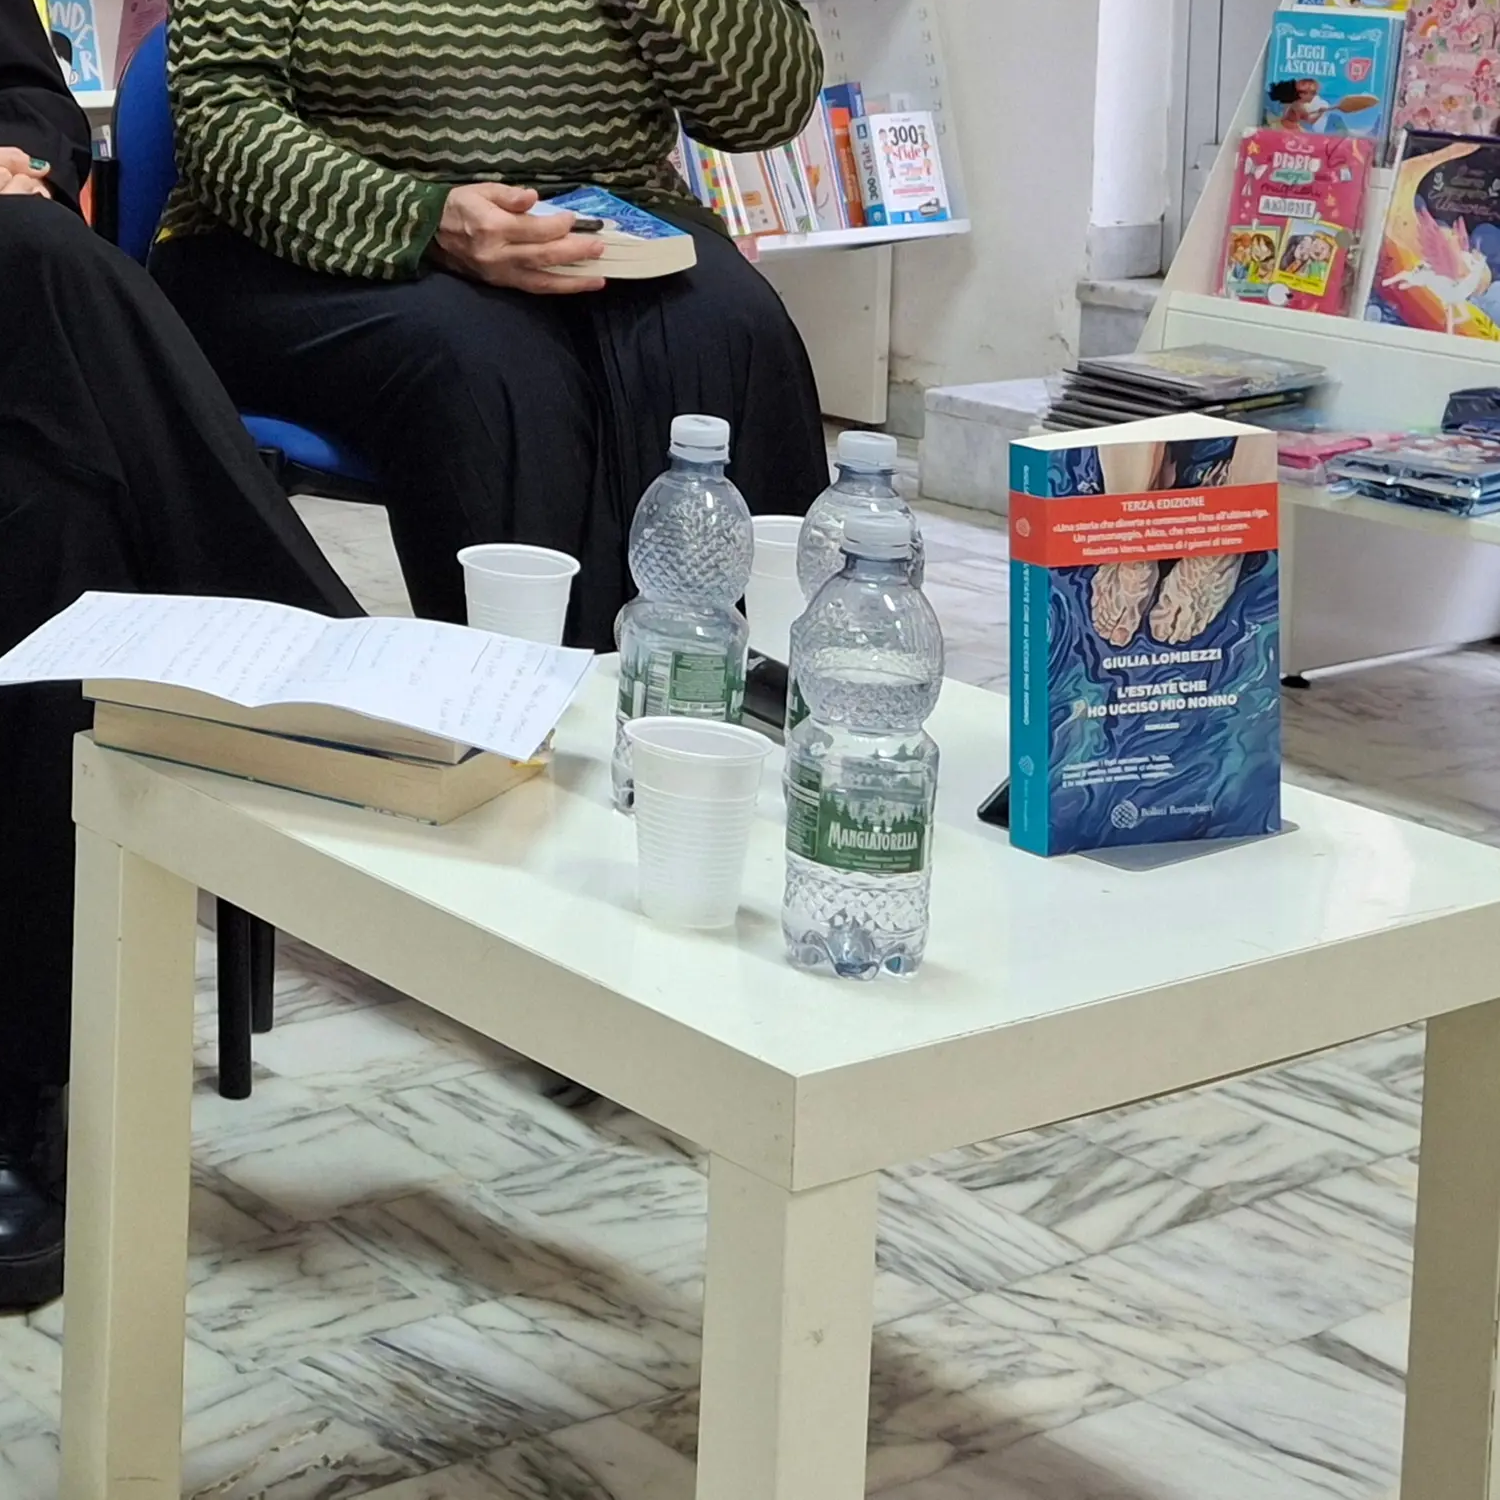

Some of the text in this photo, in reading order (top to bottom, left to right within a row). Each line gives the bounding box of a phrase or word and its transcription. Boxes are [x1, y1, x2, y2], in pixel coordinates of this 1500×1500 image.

[1285, 37, 1326, 60] LEGGI
[1283, 60, 1337, 77] ASCOLTA
[887, 124, 920, 146] 300
[866, 176, 879, 202] 300
[1120, 496, 1206, 512] TERZA EDIZIONE
[1073, 534, 1087, 544] Un
[1169, 526, 1184, 536] che
[1075, 521, 1100, 532] storia
[1099, 520, 1115, 530] che
[1102, 648, 1222, 670] GIULIA LOMBEZZI
[1117, 680, 1207, 699] L'ESTATE CHE
[1087, 694, 1238, 718] HO UCCISO MIO NONNO
[1141, 803, 1213, 817] Bollati Boringhieri
[827, 822, 919, 852] MANGIATORELLA
